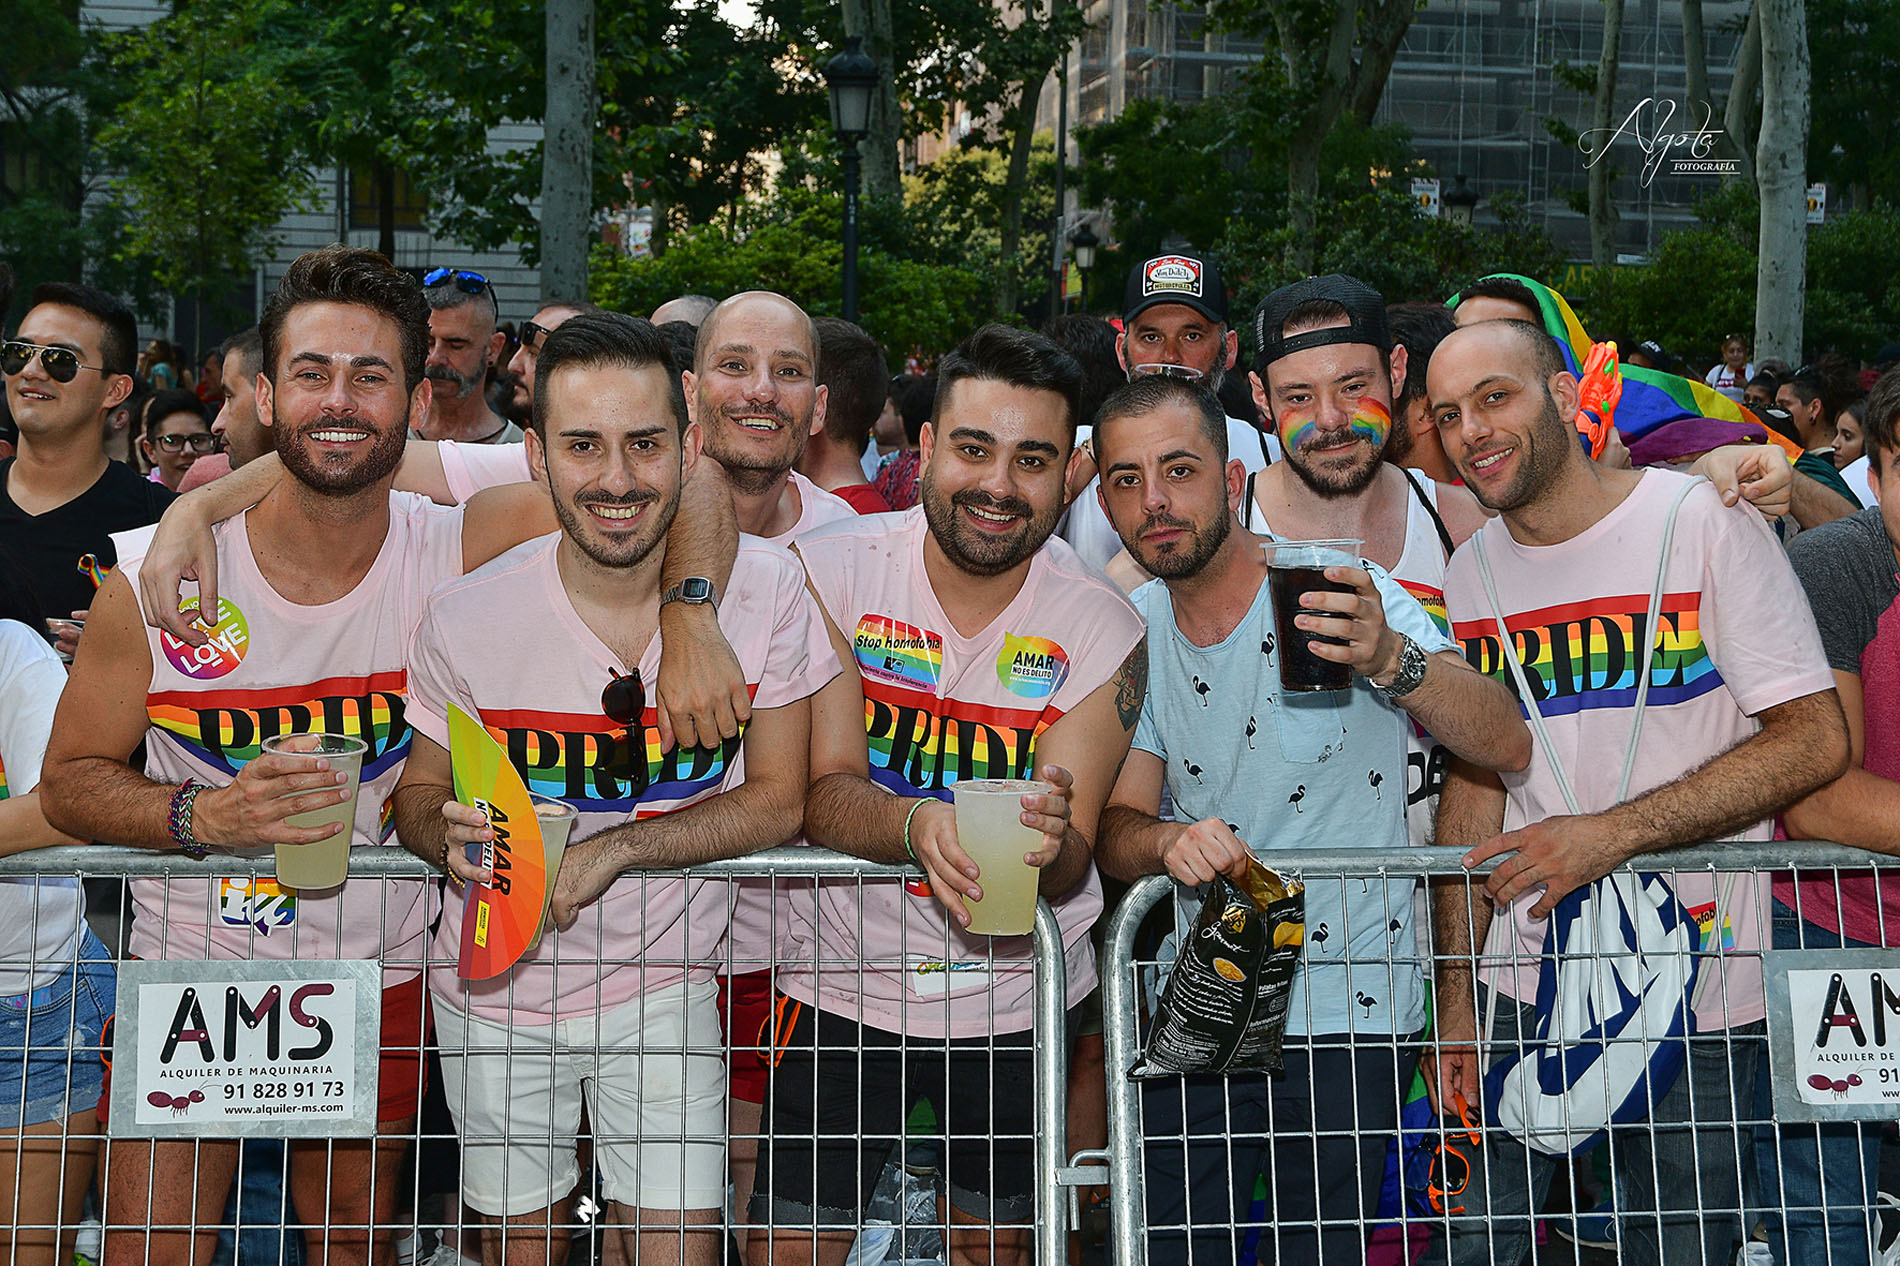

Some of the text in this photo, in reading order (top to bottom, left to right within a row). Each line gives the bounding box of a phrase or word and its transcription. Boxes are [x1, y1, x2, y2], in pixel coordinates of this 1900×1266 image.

[180, 622, 247, 674] LOVE
[856, 634, 882, 651] Stop
[1012, 650, 1055, 670] AMAR
[1458, 611, 1684, 702] PRIDE
[1012, 666, 1052, 678] NO ES DELITO
[488, 802, 512, 895] AMAR
[160, 983, 334, 1064] AMS
[1817, 1052, 1895, 1063] ALQUILER DE
[160, 1065, 333, 1080] ALQUILER DE MAQUINARIA
[1879, 1068, 1899, 1083] 91
[223, 1081, 345, 1099] 91 828 91 73
[224, 1102, 344, 1116] www.alquiler-ms.com
